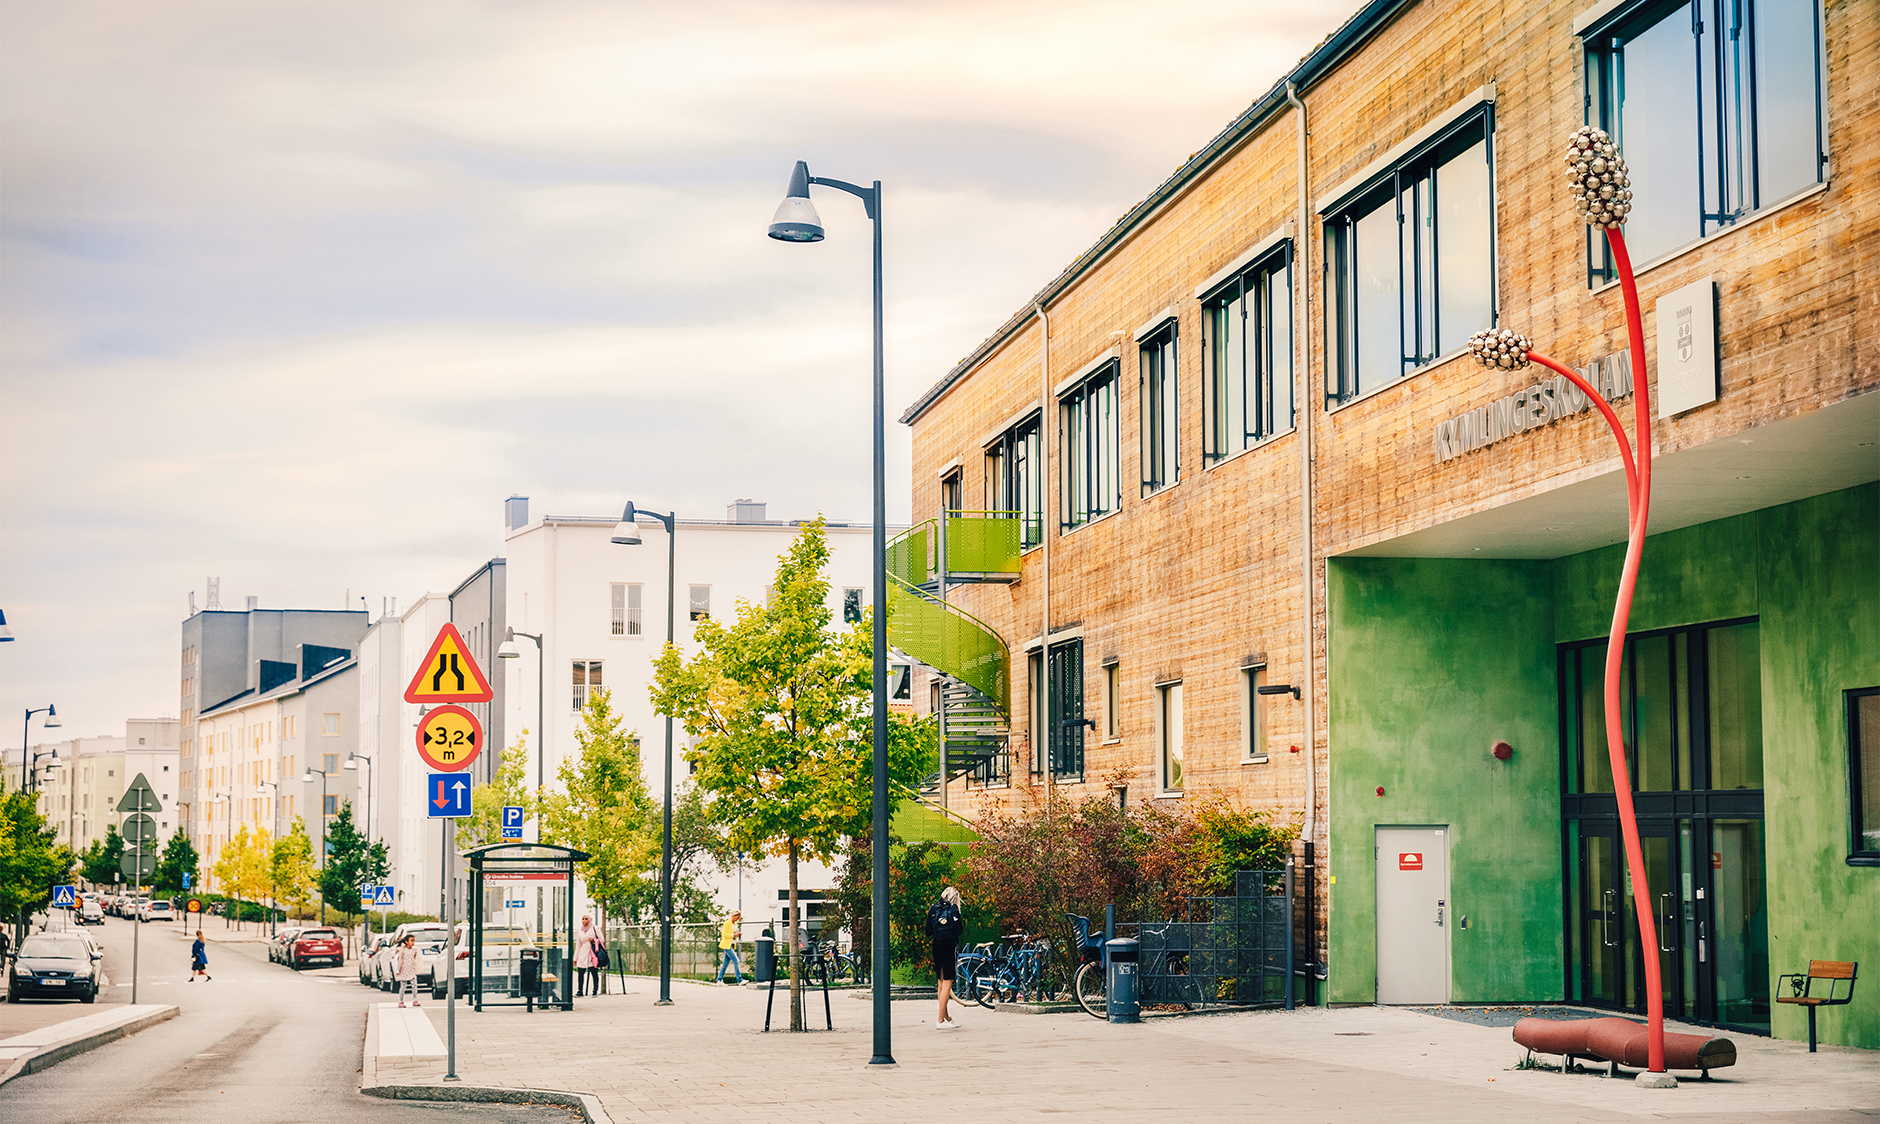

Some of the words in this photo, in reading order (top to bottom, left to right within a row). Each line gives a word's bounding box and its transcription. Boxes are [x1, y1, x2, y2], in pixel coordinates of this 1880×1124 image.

[434, 727, 464, 748] 3,2
[444, 751, 454, 760] m
[507, 808, 520, 825] P
[364, 884, 372, 893] P
